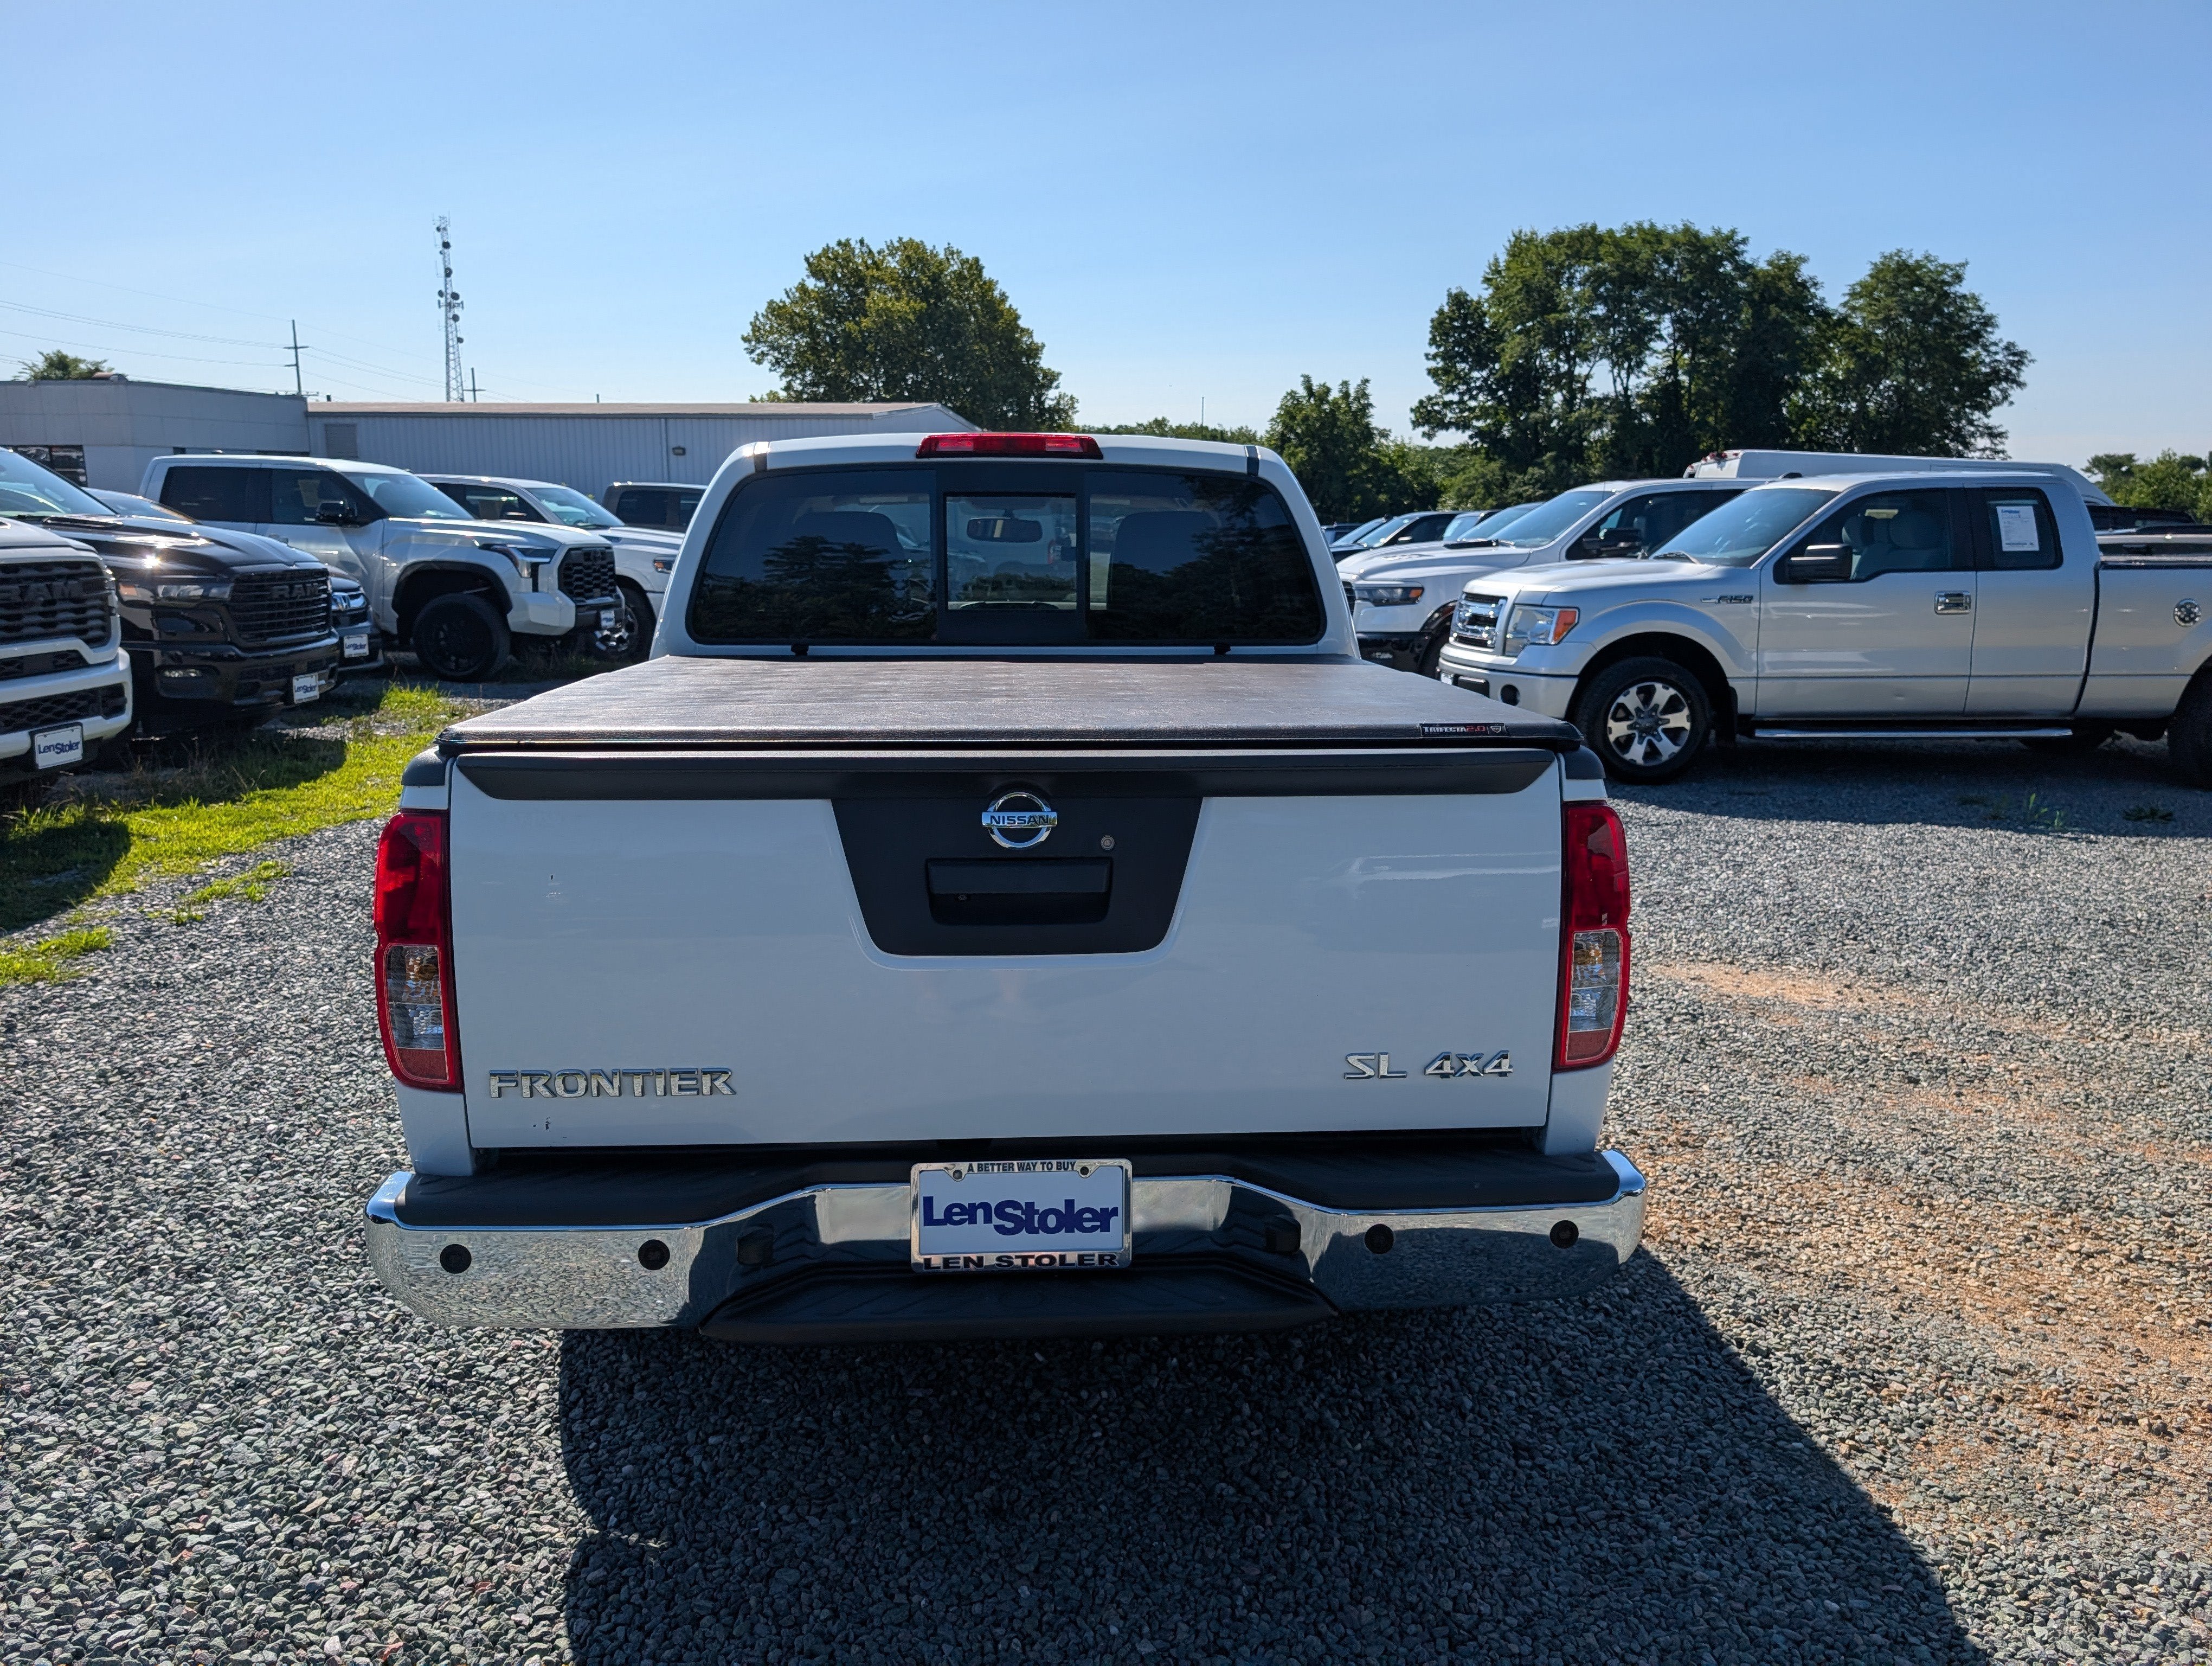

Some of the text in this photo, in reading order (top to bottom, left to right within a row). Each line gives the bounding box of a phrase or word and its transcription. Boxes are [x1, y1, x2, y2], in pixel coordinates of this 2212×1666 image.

[271, 582, 319, 598] RAM
[38, 740, 80, 754] LenStoler
[990, 815, 1049, 824] NISSAN
[1344, 1052, 1407, 1079] SL
[488, 1067, 737, 1098] FRONTIER
[967, 1161, 1076, 1173] A BETTER WAY TO BUY
[923, 1196, 1118, 1236] LenStoler
[923, 1253, 1120, 1270] LEN STOLER
